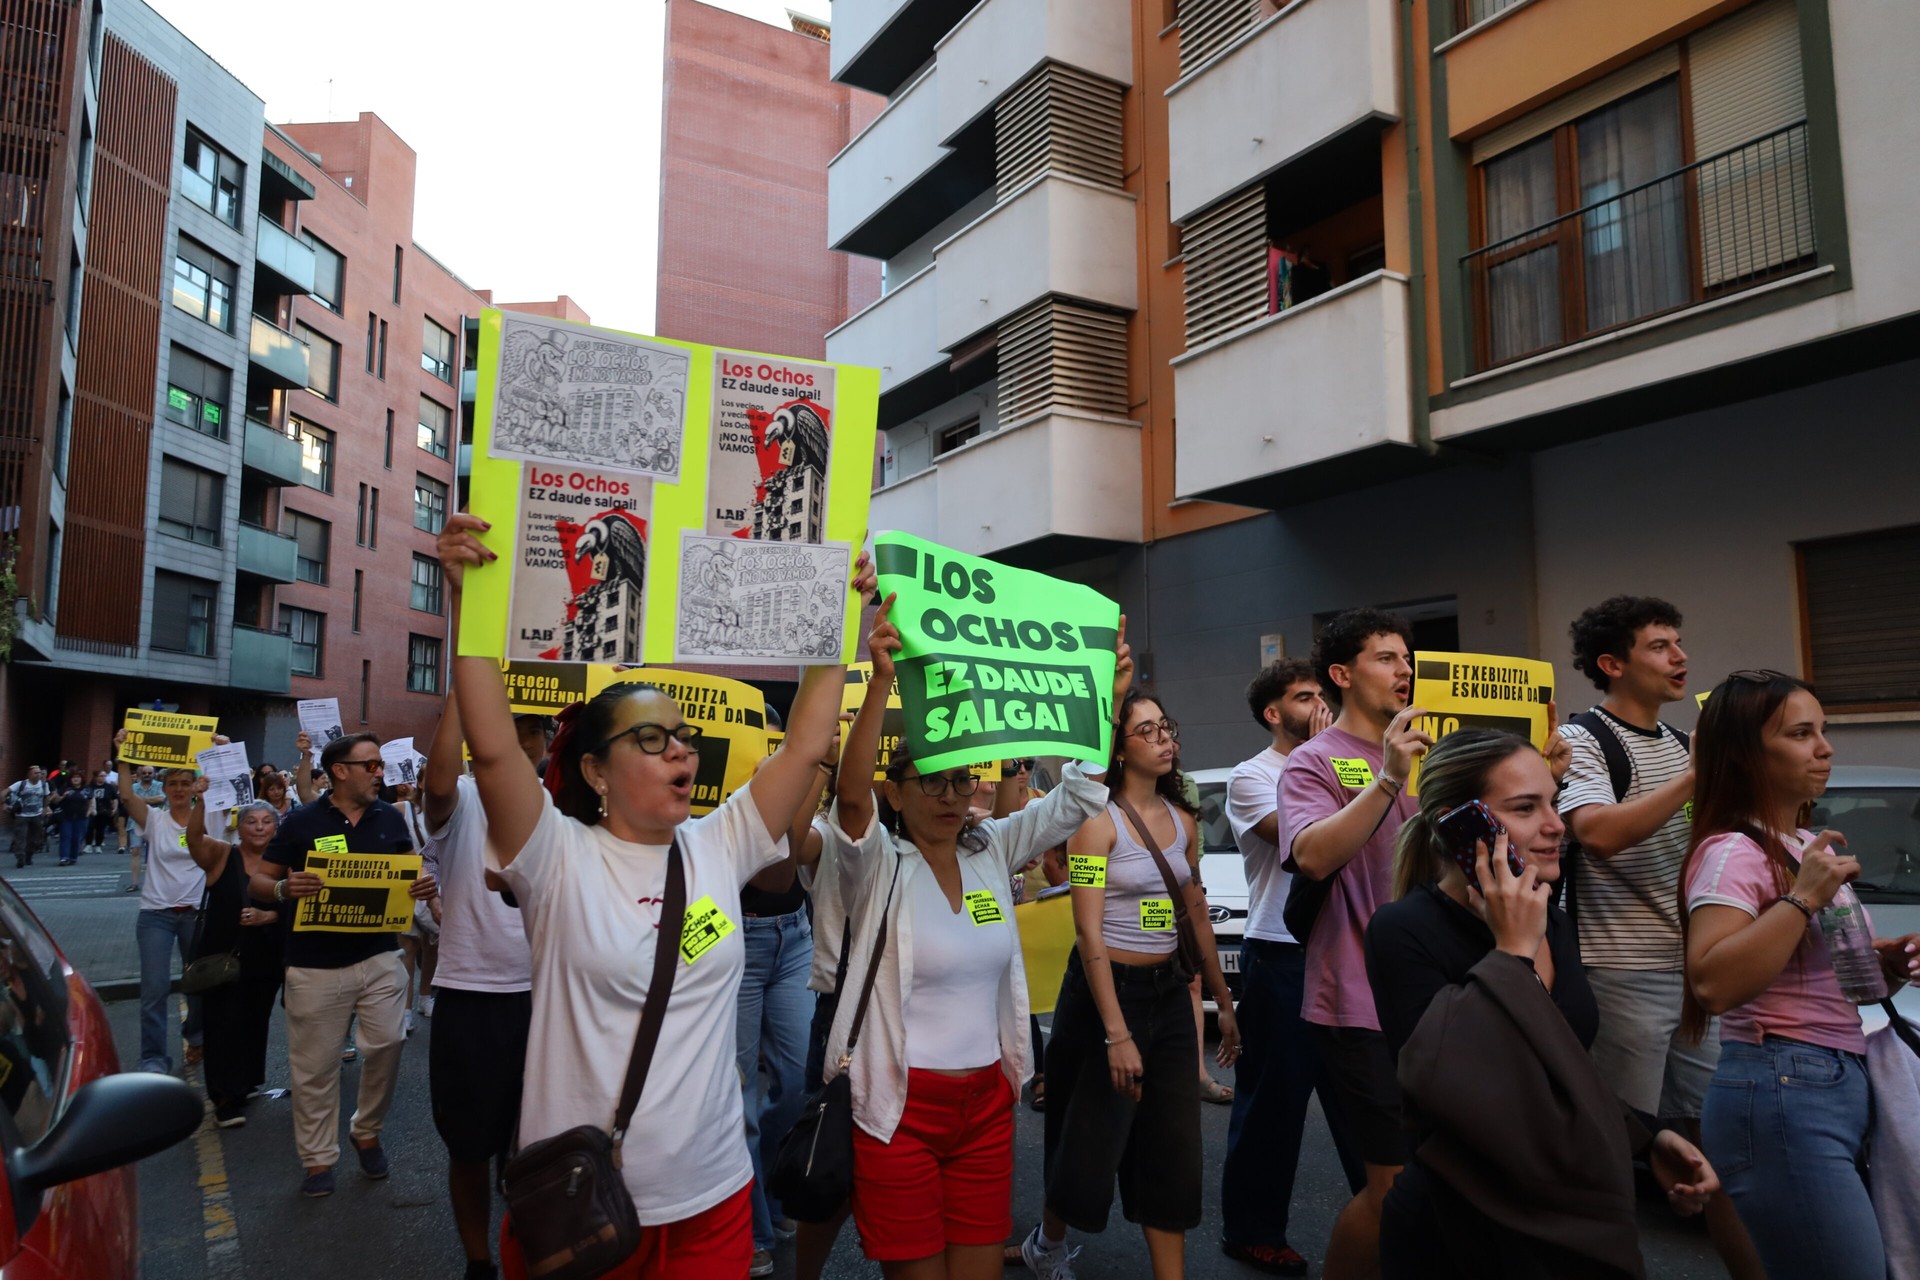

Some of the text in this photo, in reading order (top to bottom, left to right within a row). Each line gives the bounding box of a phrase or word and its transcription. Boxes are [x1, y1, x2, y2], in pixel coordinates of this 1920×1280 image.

[568, 350, 649, 370] LOS OCHOS
[592, 369, 612, 382] NOS
[722, 359, 814, 386] Los Ochos
[722, 378, 821, 400] EZ daude salgai!
[722, 399, 764, 411] Los vecinos
[720, 420, 758, 431] Los Ochos
[719, 432, 760, 444] ¡NO NOS
[531, 467, 630, 495] Los Ochos
[529, 488, 637, 511] EZ daude salgai!
[528, 511, 574, 522] Los vecinos
[717, 508, 745, 520] LAB
[526, 534, 567, 544] Los Ochos
[525, 547, 570, 558] ¡NO NOS
[742, 546, 757, 555] LOS
[759, 546, 790, 554] VECINOS
[737, 553, 812, 571] LOS OCHOS
[760, 570, 779, 582] NOS
[924, 552, 996, 604] LOS
[521, 628, 553, 641] LAB
[920, 608, 1080, 652] OCHOS
[924, 661, 1090, 699] EZ DAUDE
[1453, 664, 1529, 685] ETXEBIZITZA
[522, 688, 584, 704] VIVIENDA
[1452, 682, 1538, 703] ESKUBIDEA DA
[725, 708, 743, 724] DA
[924, 698, 1070, 743] SALGAI
[126, 732, 144, 743] NO
[137, 745, 172, 753] NEGOCIO
[329, 859, 390, 870] ETXEBIZITZA
[328, 869, 399, 879] ESKUBIDEA DA
[303, 904, 365, 914] AL NEGOCIO
[302, 913, 383, 924] DE LA VIVIENDA
[683, 912, 711, 939] OCHOS
